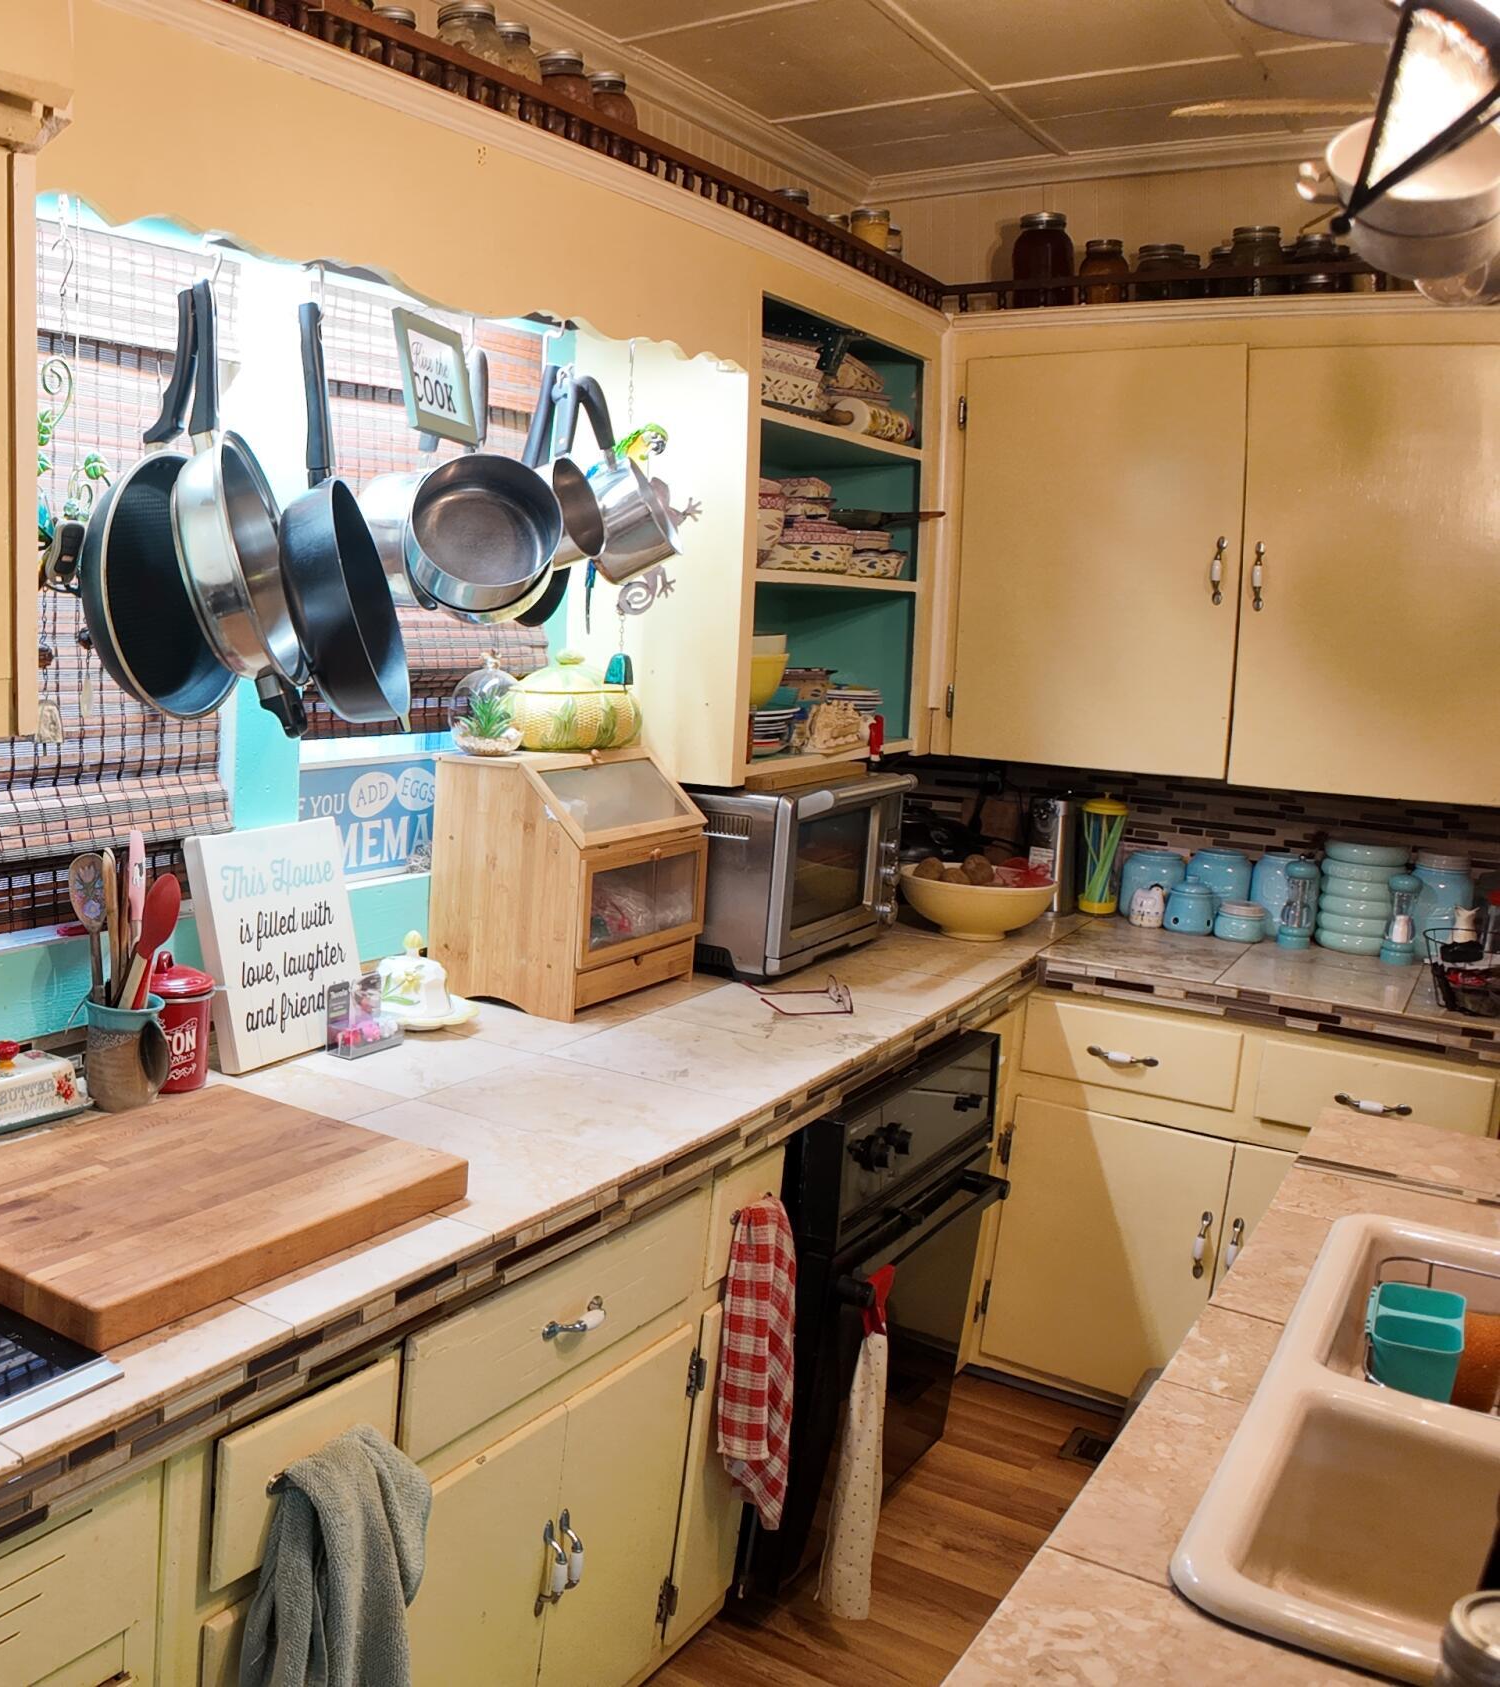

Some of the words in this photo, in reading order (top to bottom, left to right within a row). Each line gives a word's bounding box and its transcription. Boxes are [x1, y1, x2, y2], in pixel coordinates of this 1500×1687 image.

[413, 371, 457, 414] COOK
[310, 793, 345, 817] YOU
[356, 782, 389, 808] ADD
[401, 777, 435, 803] EGGS
[338, 813, 430, 869] MEMA
[220, 864, 267, 902] This
[271, 857, 334, 895] House
[240, 917, 254, 944] is
[257, 906, 298, 951] filled
[301, 900, 334, 930] with
[242, 961, 279, 989] love,
[284, 942, 346, 981] laughter
[246, 998, 277, 1032] and
[280, 984, 325, 1034] friend
